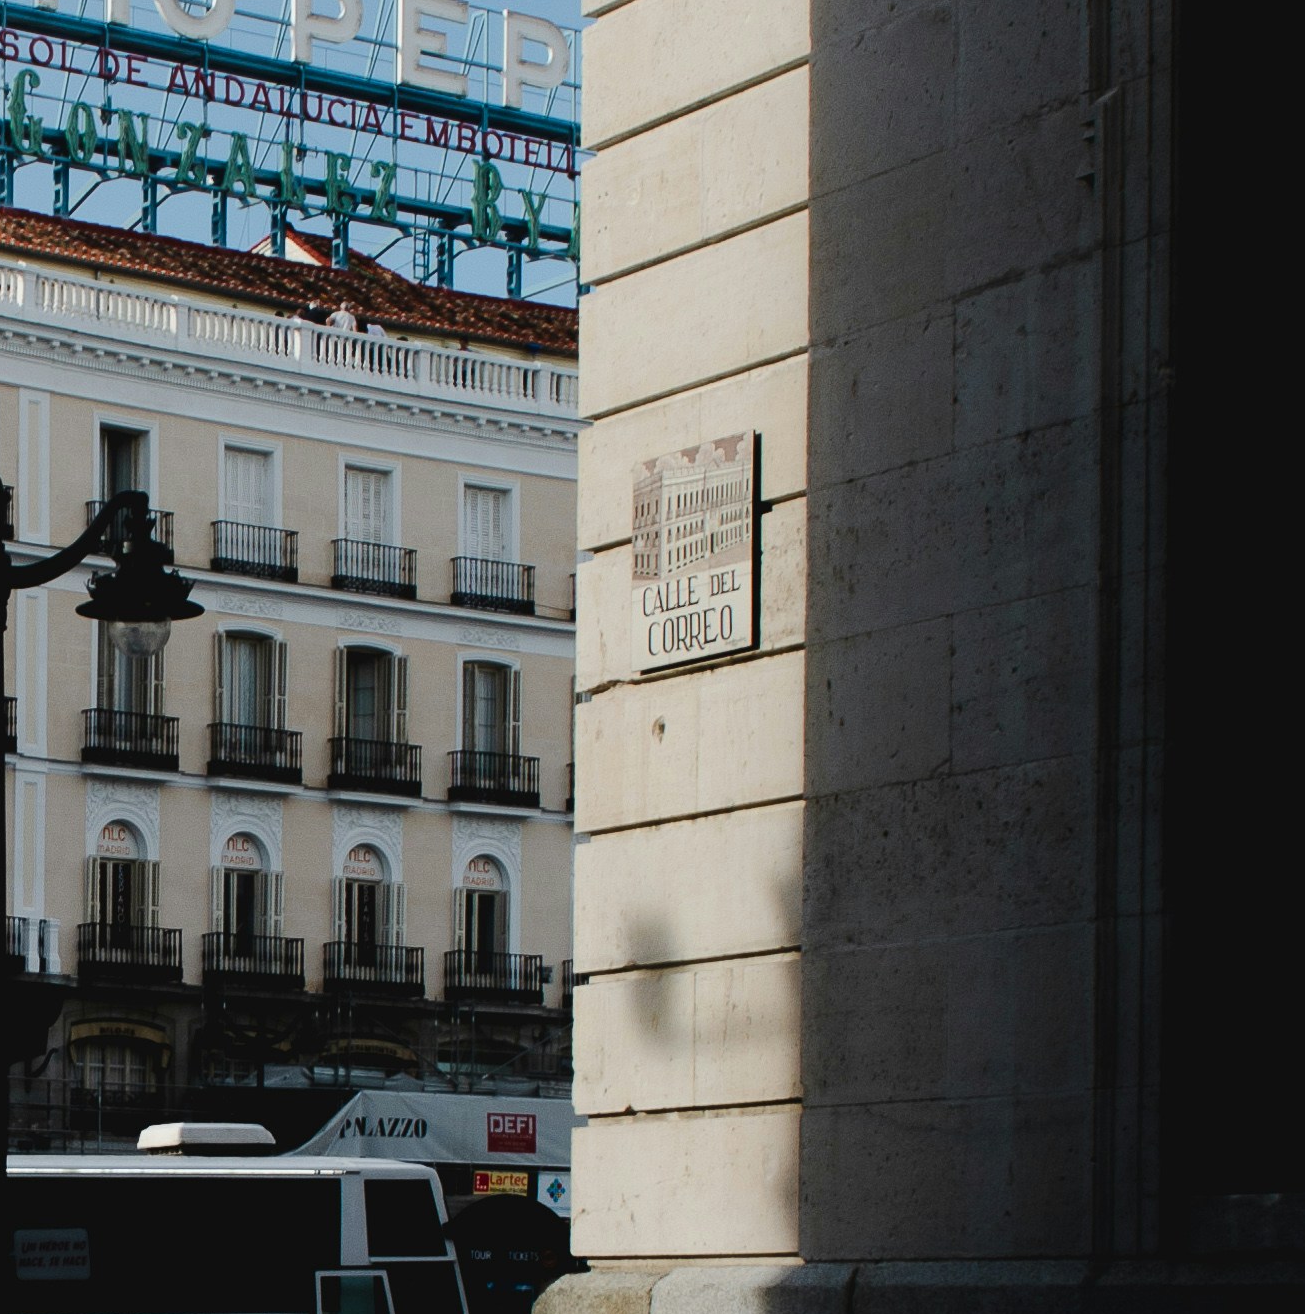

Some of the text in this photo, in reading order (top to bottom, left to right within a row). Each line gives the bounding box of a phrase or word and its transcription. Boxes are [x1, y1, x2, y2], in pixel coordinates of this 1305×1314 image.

[99, 47, 149, 87] DE
[168, 64, 384, 136] ANDALUCIA
[7, 69, 397, 223] GONZALEZ
[642, 569, 741, 617] CALLE DEL
[648, 604, 734, 656] CORREO
[490, 1116, 533, 1134] DEFI
[490, 1173, 527, 1186] Lartec
[471, 1249, 540, 1261] TOUR TICKETS
